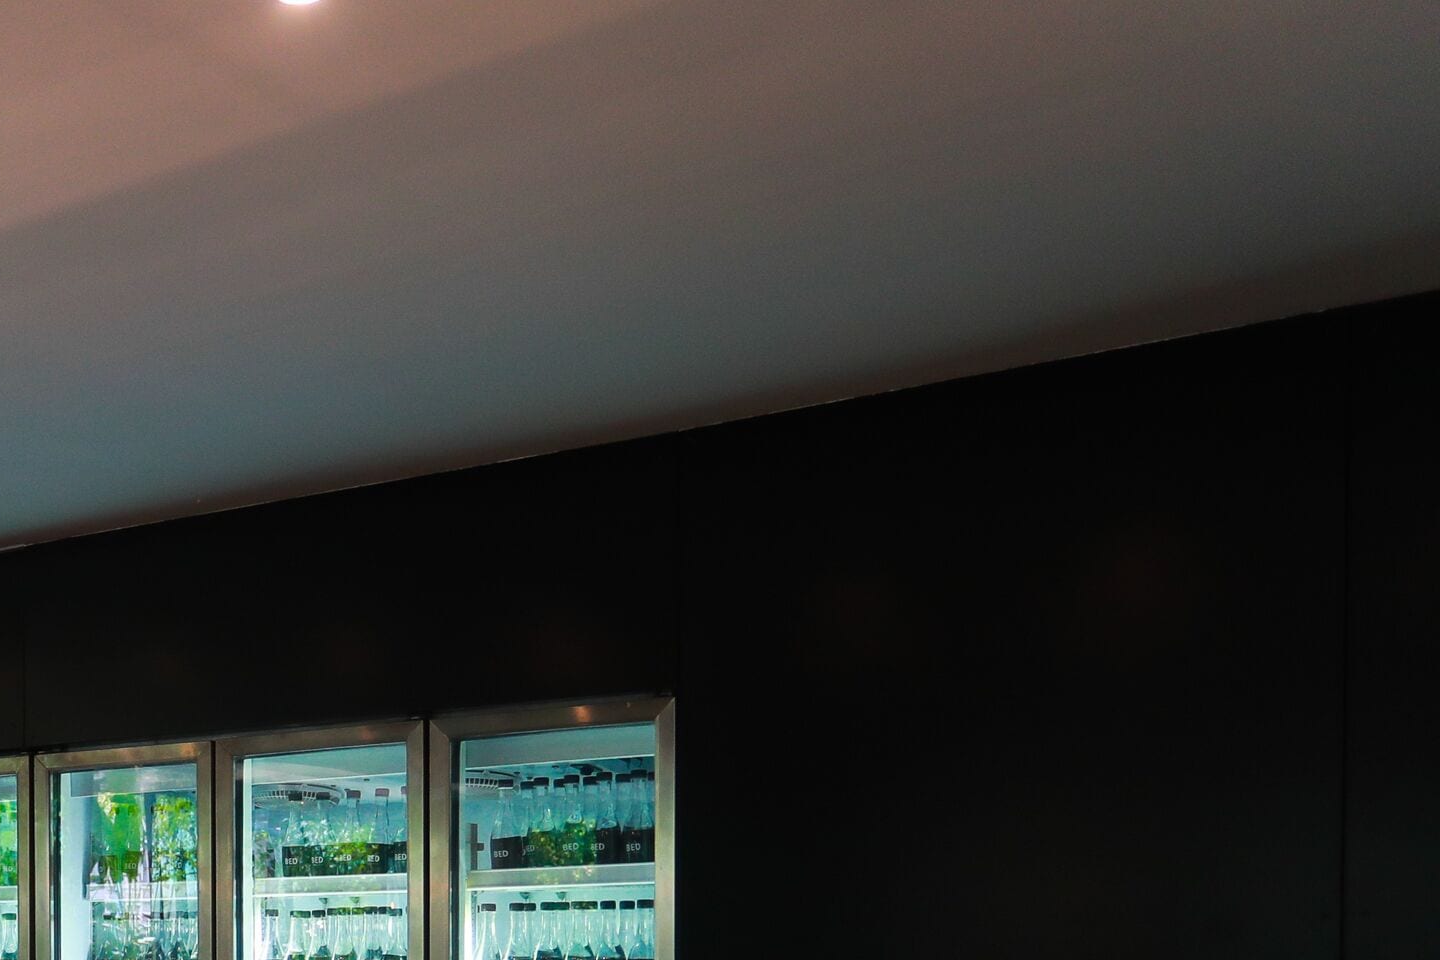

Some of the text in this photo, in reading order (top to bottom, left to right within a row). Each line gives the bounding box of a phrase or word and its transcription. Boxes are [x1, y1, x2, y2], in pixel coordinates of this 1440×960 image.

[562, 843, 579, 851] BED
[590, 843, 605, 851] BED
[626, 843, 641, 851] BED
[493, 850, 509, 858] BED
